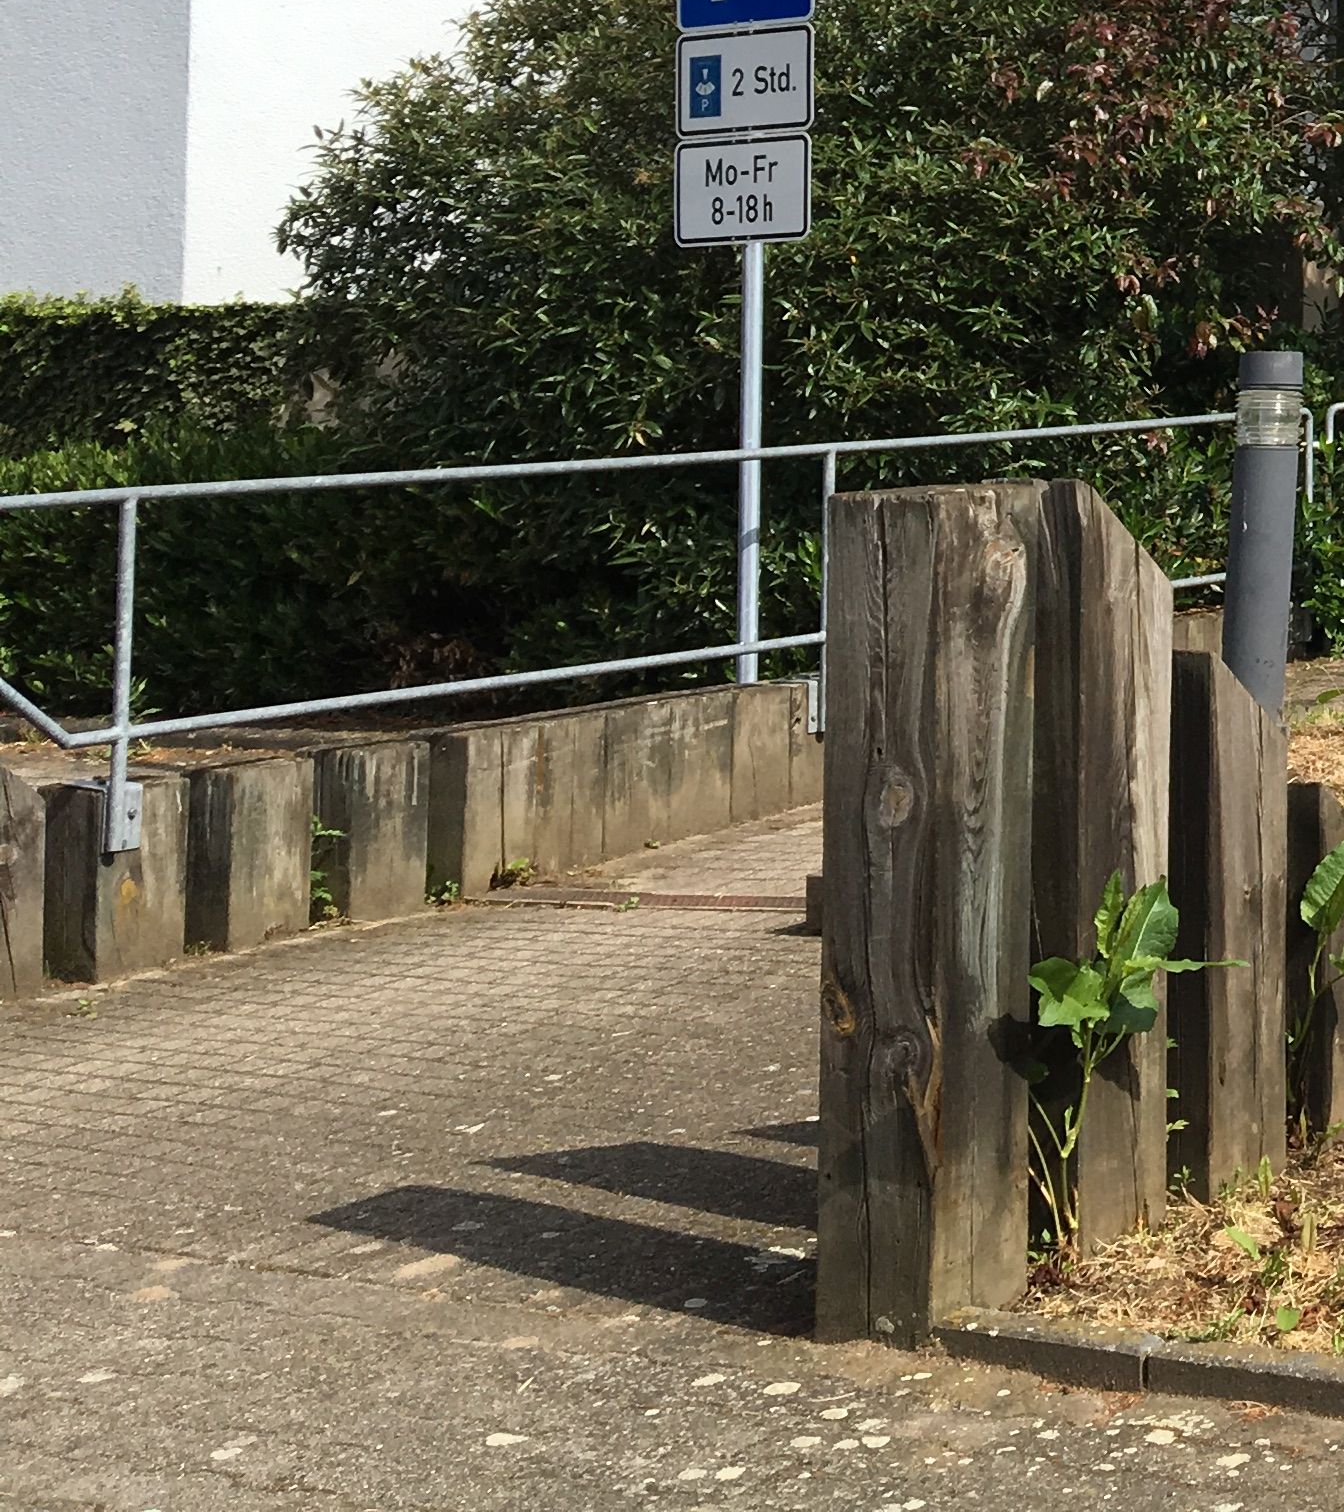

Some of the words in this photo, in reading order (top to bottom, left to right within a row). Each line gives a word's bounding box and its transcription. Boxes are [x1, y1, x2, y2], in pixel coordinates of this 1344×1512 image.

[732, 68, 744, 96] 2
[754, 63, 797, 95] Std.
[705, 154, 778, 187] Mo-Fr
